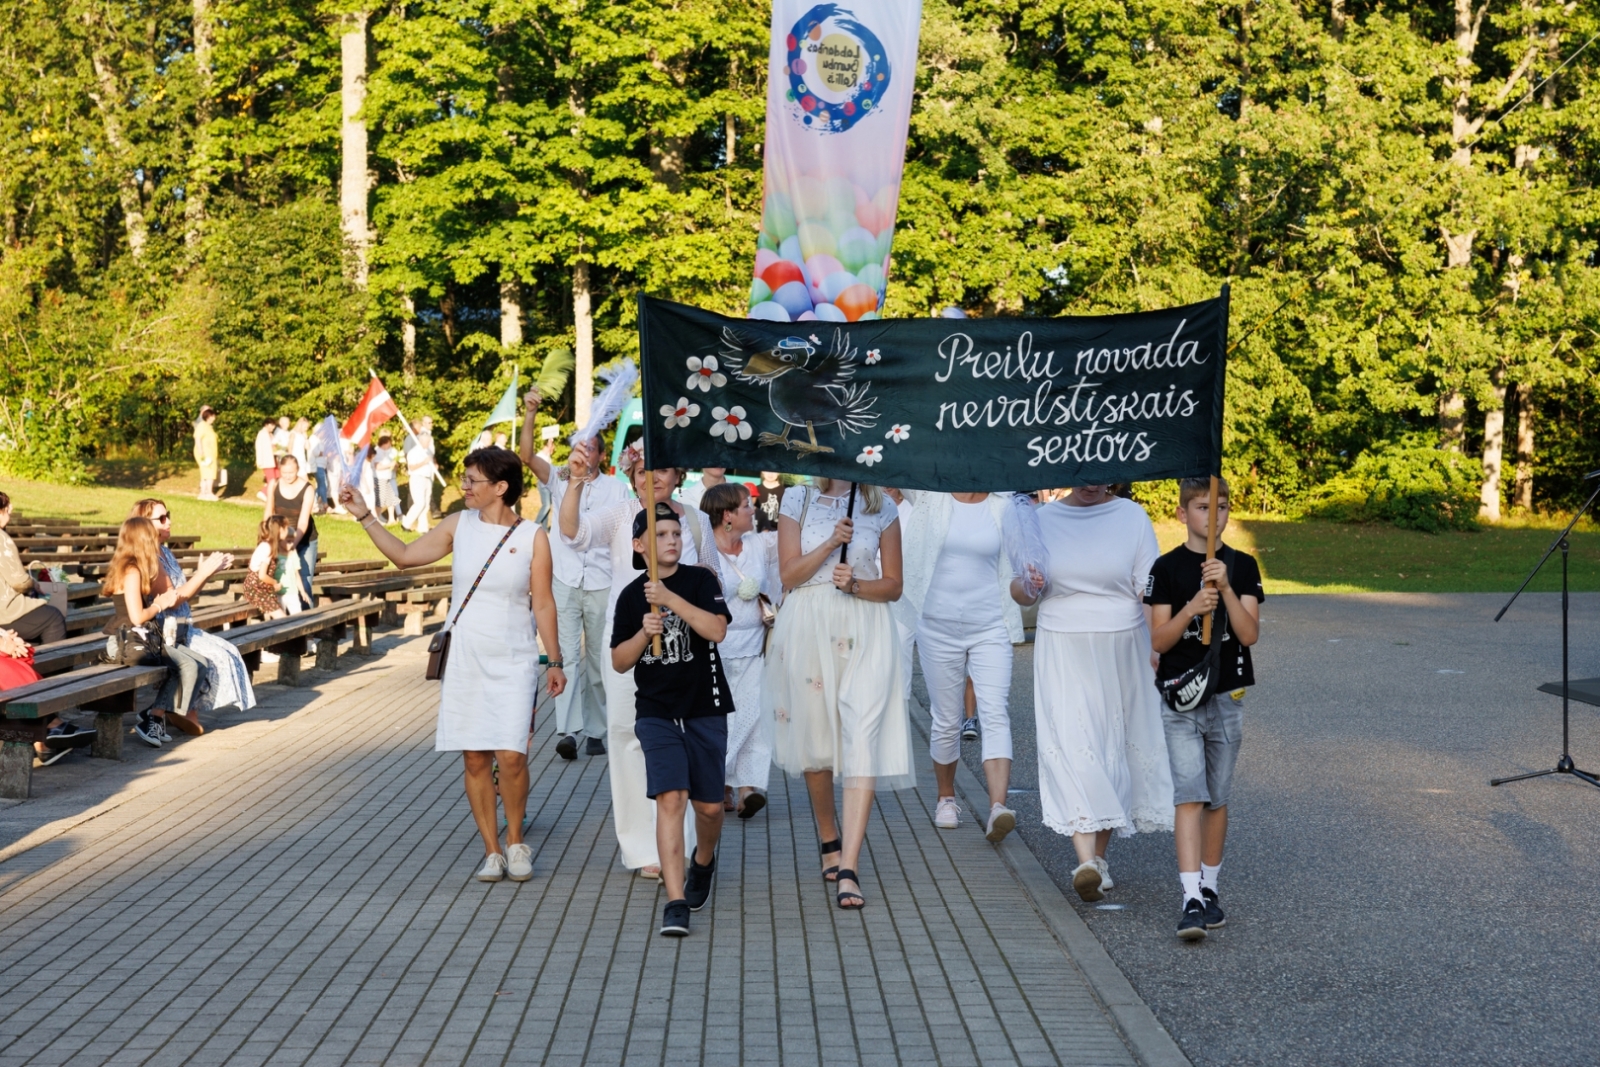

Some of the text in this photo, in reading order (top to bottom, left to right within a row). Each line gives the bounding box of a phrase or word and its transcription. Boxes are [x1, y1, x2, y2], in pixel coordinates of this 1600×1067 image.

[934, 318, 1211, 383] Preiļu novada
[935, 376, 1200, 431] nevalstiskais
[1026, 420, 1157, 467] sektors
[708, 641, 720, 707] BOXING
[1177, 671, 1203, 703] NIKE
